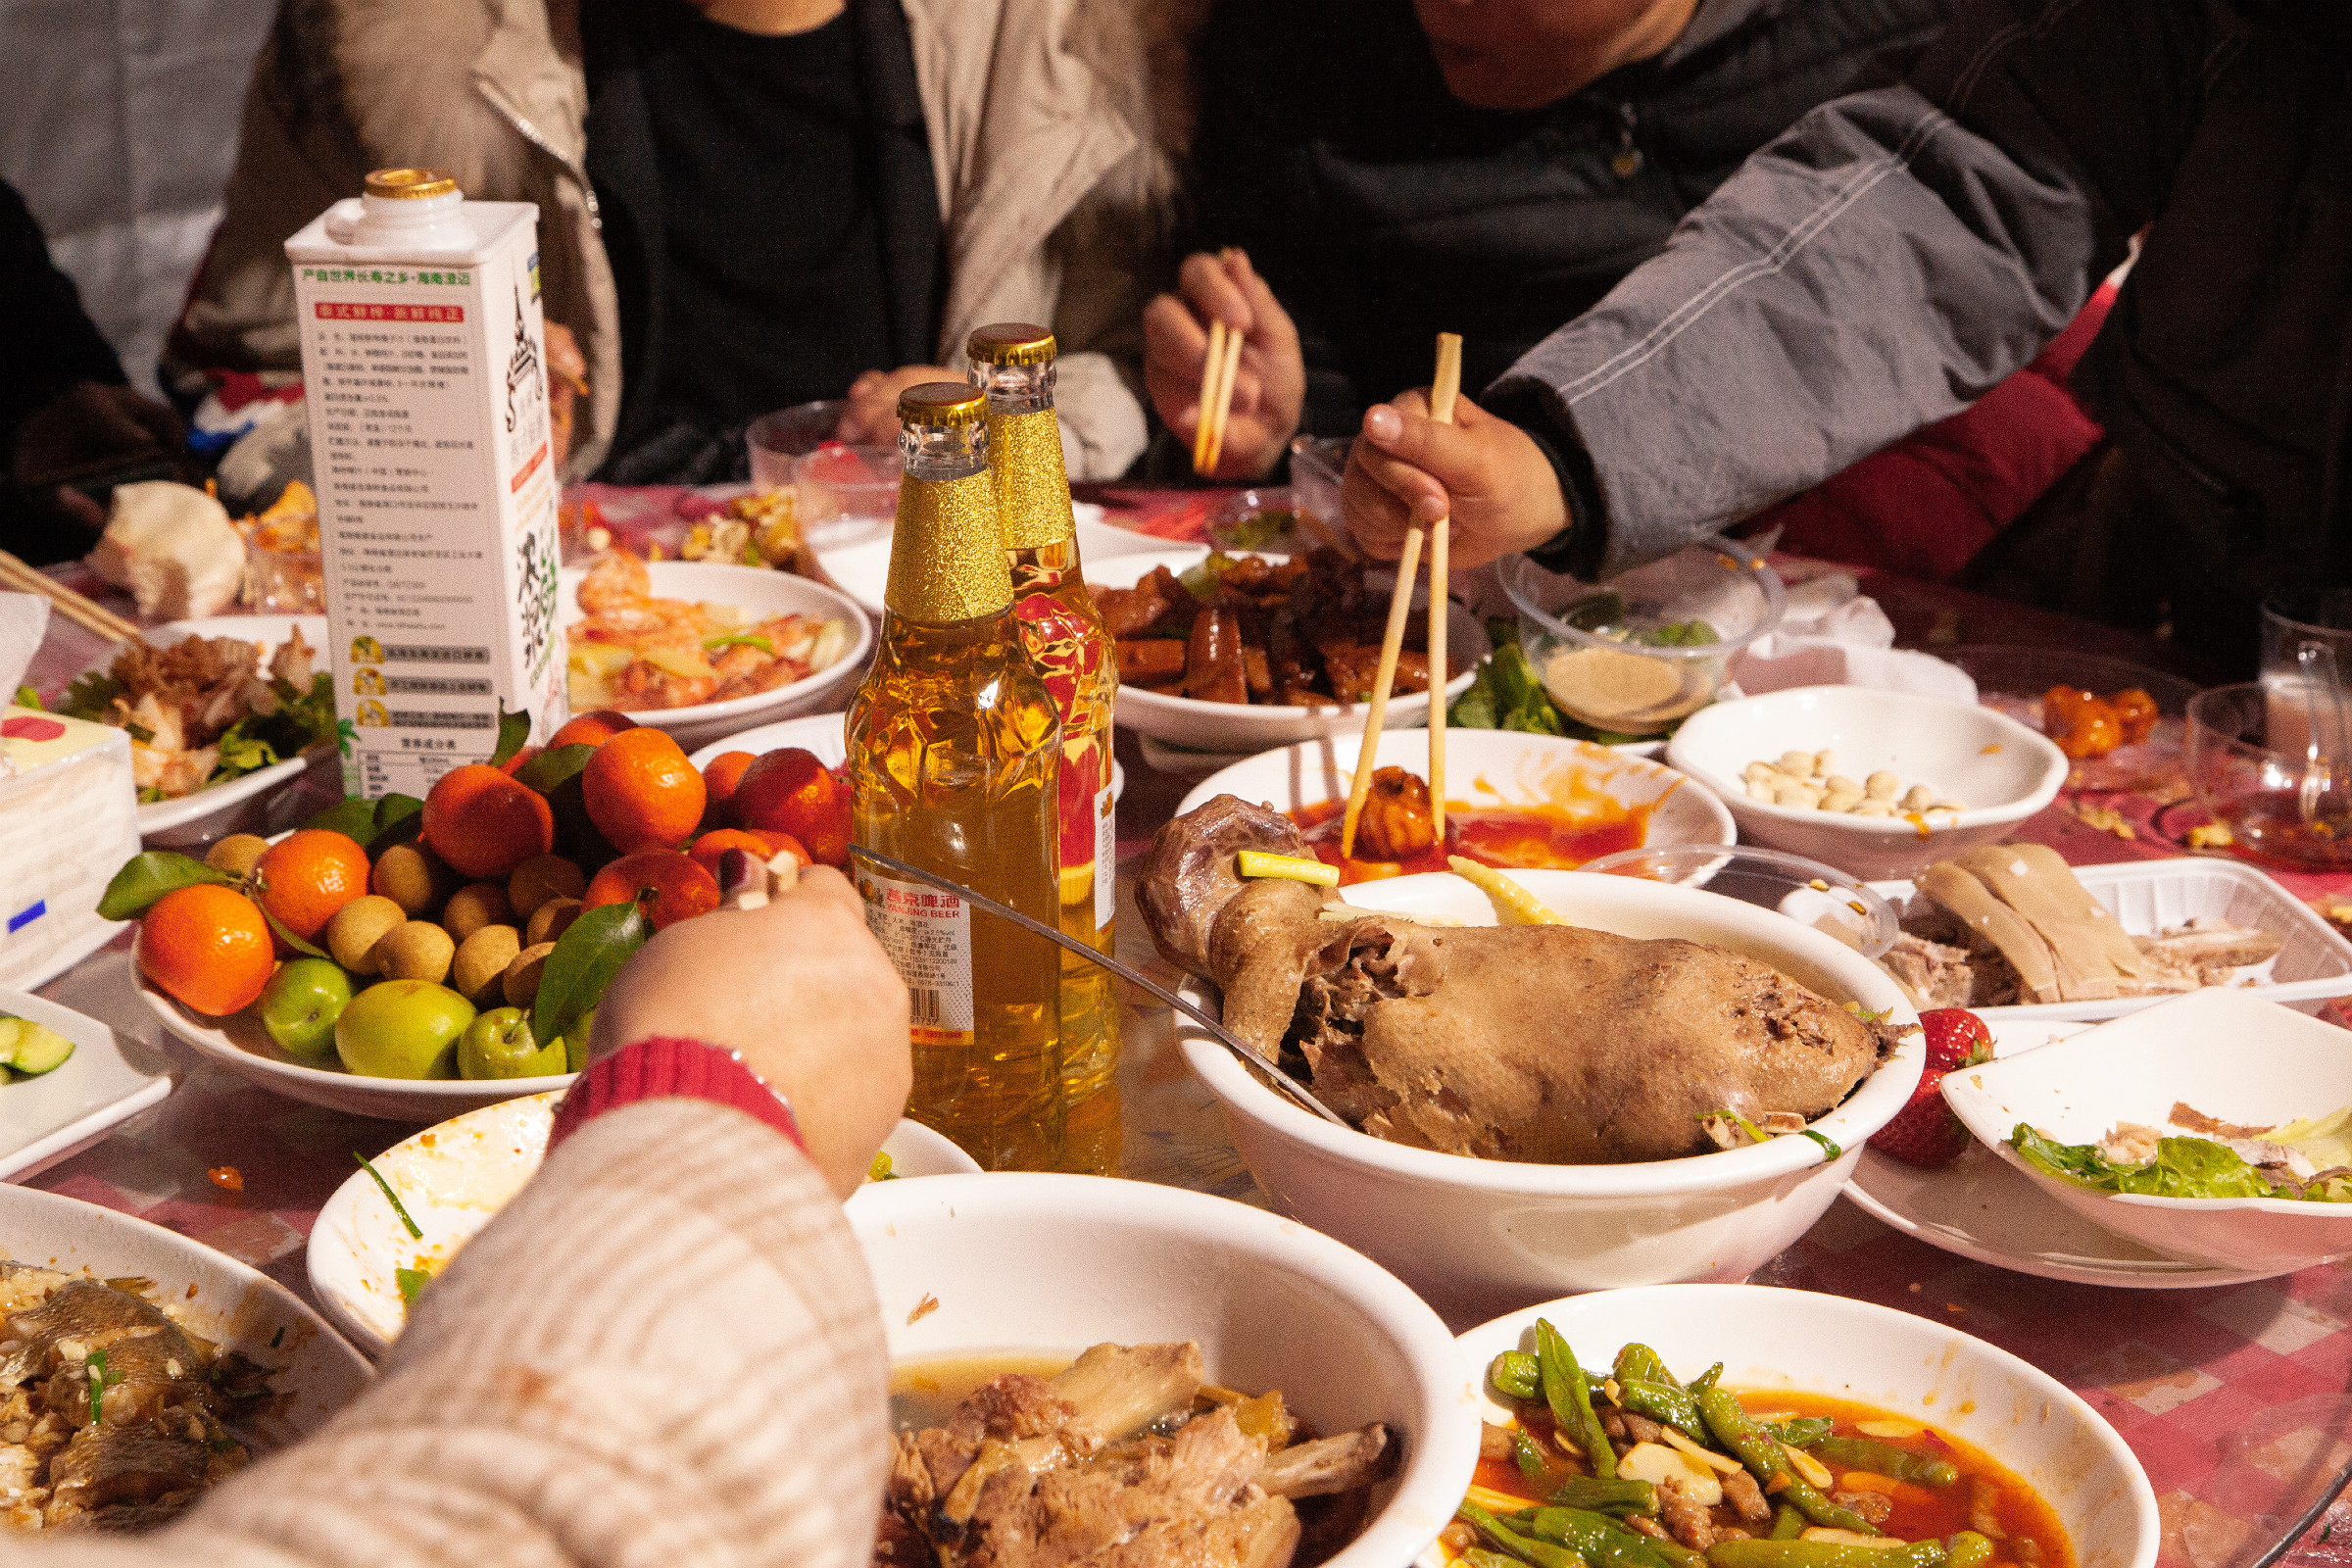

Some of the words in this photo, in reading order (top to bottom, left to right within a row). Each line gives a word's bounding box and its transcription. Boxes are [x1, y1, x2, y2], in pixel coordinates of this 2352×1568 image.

[886, 888, 960, 908] 燕京啤酒
[886, 905, 928, 917] YANJING
[930, 909, 960, 919] BEER
